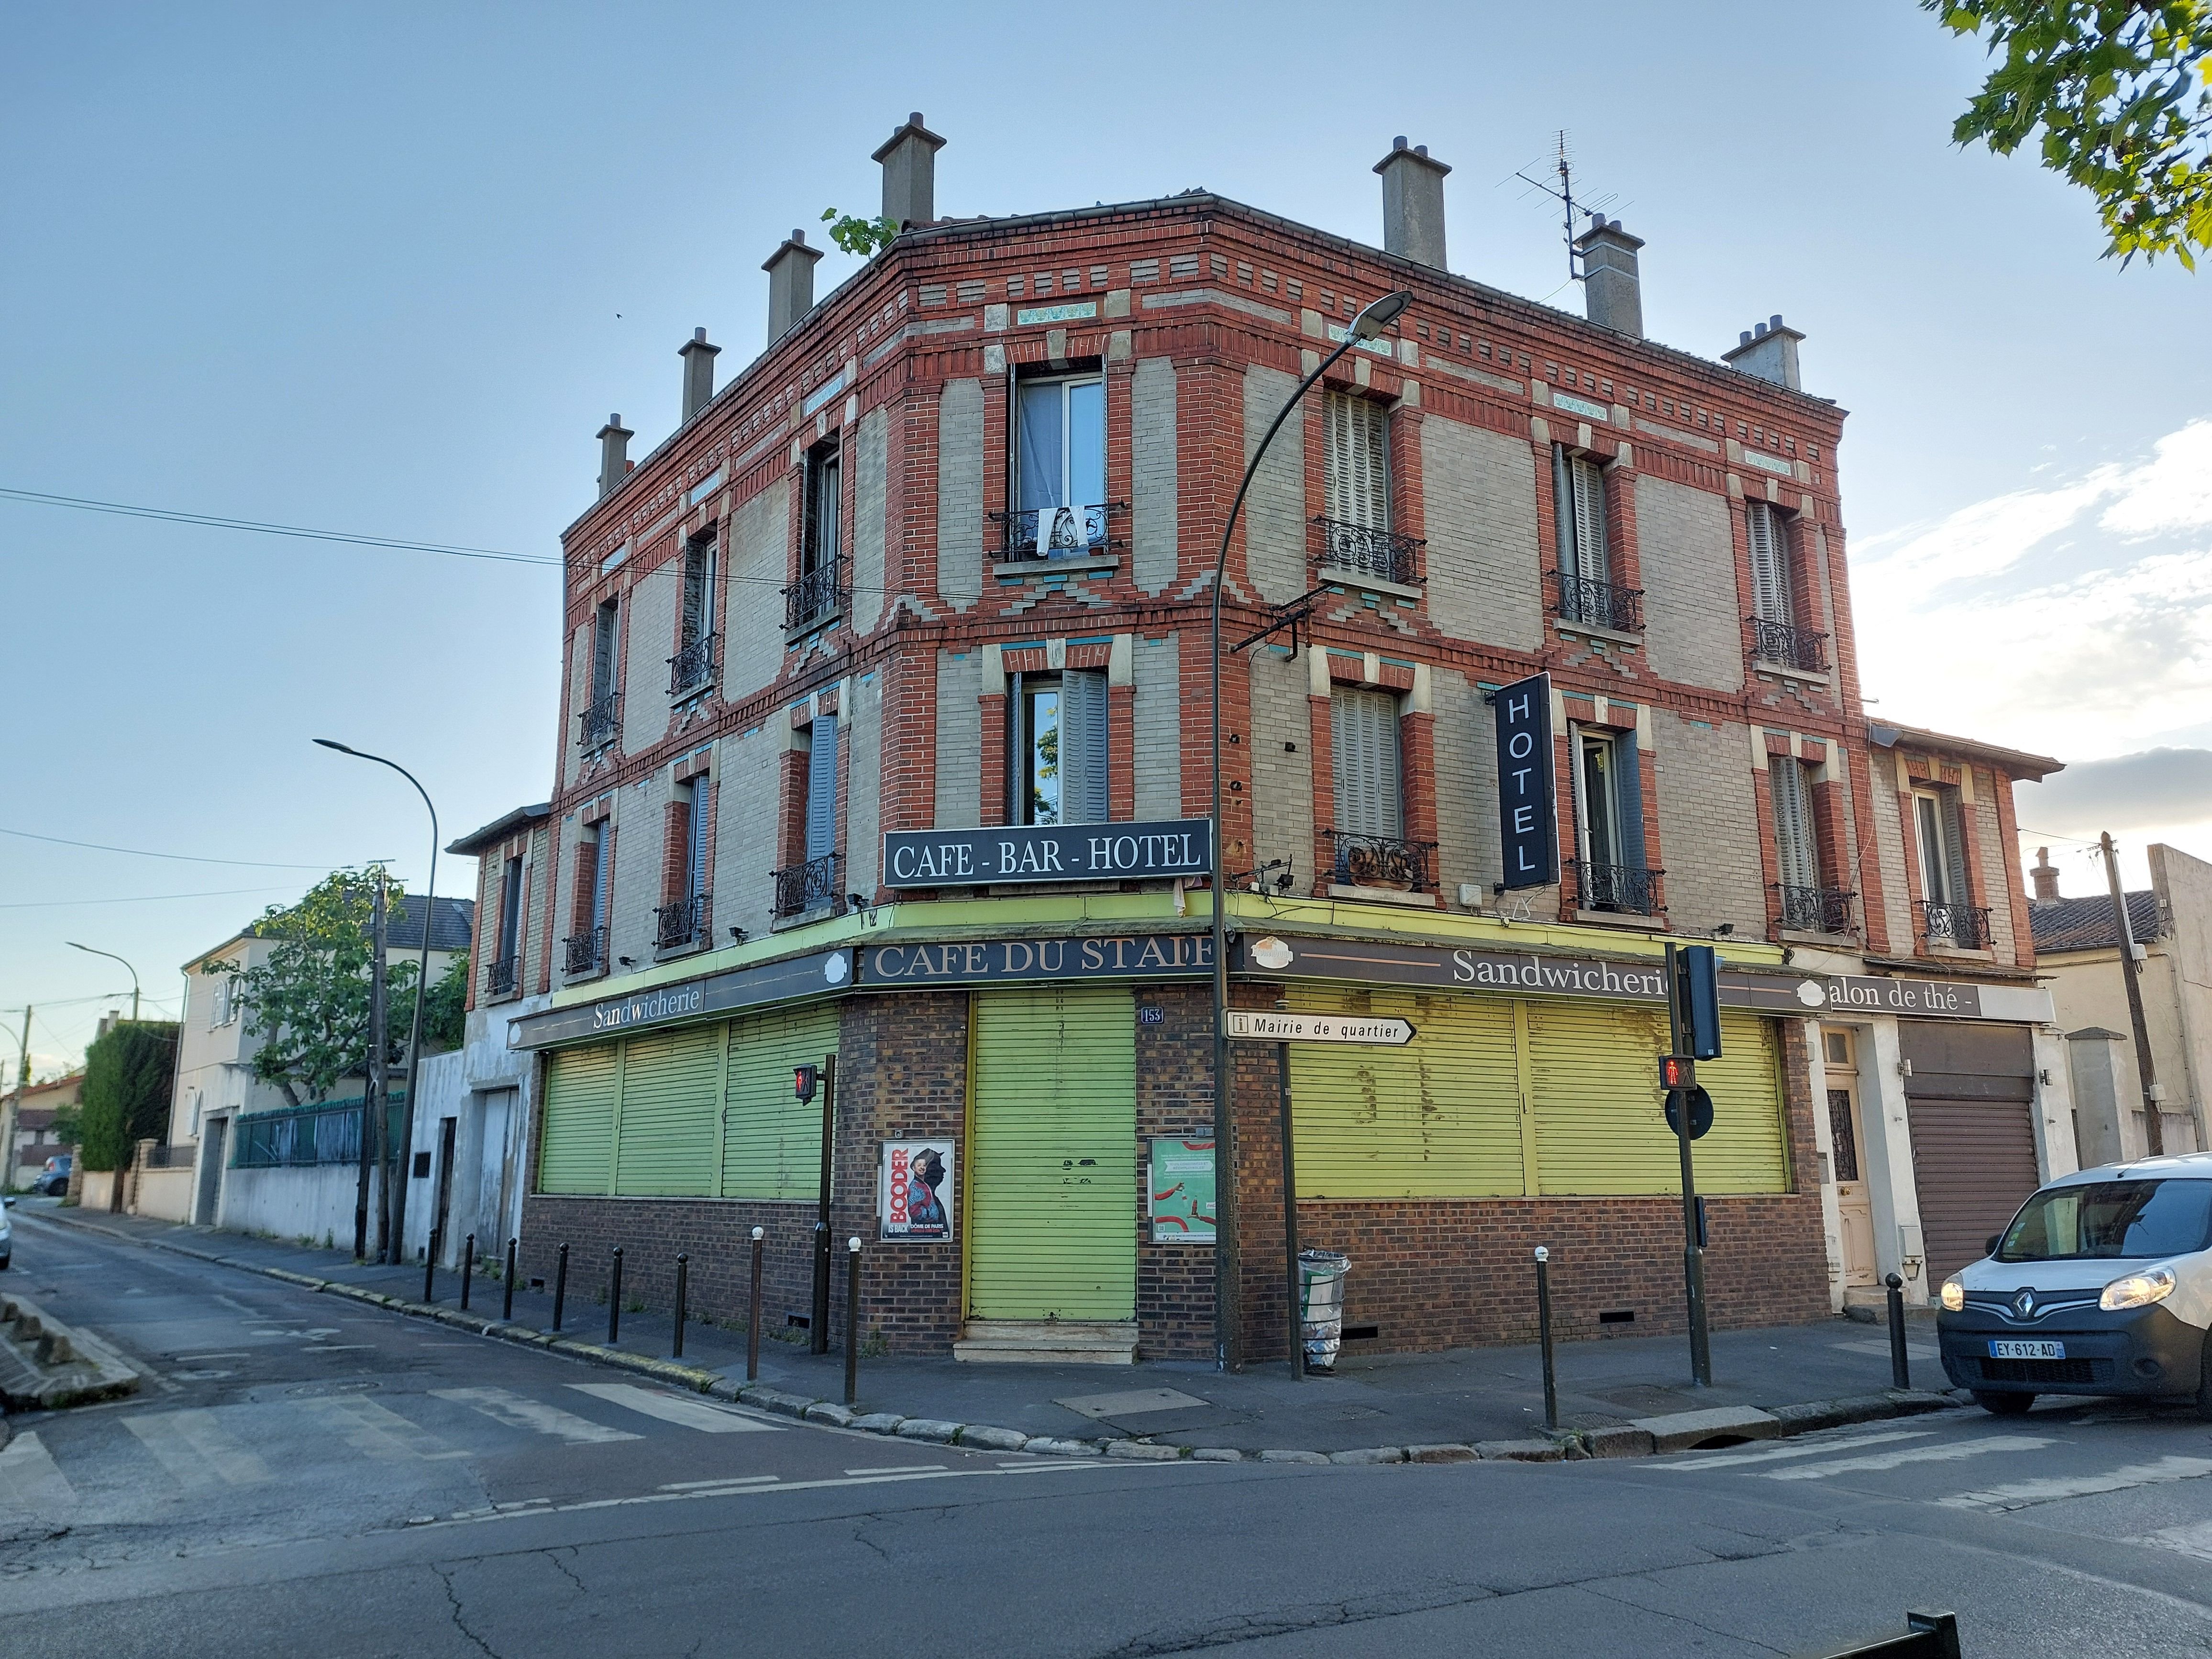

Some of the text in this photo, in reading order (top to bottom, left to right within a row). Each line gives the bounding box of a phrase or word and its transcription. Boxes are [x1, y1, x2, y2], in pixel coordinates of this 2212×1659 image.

[1508, 693, 1536, 871] HOTEL
[893, 844, 974, 879] CAFE
[997, 840, 1064, 874] BAR
[1087, 833, 1201, 870] HOTEL
[1000, 940, 1068, 973] DU
[1453, 949, 1669, 995] Sandwicheri
[593, 986, 700, 1029] Sandwicherie
[1830, 977, 1881, 1005] alon
[1888, 981, 1916, 1007] de
[1923, 983, 1958, 1010] thé
[1144, 1008, 1161, 1022] 153
[1254, 1018, 1302, 1034] Mairie
[1314, 1021, 1330, 1035] de
[1340, 1023, 1398, 1040] quartier
[890, 1148, 908, 1224] BOODER
[888, 1224, 894, 1233] IS
[894, 1224, 908, 1233] BACK
